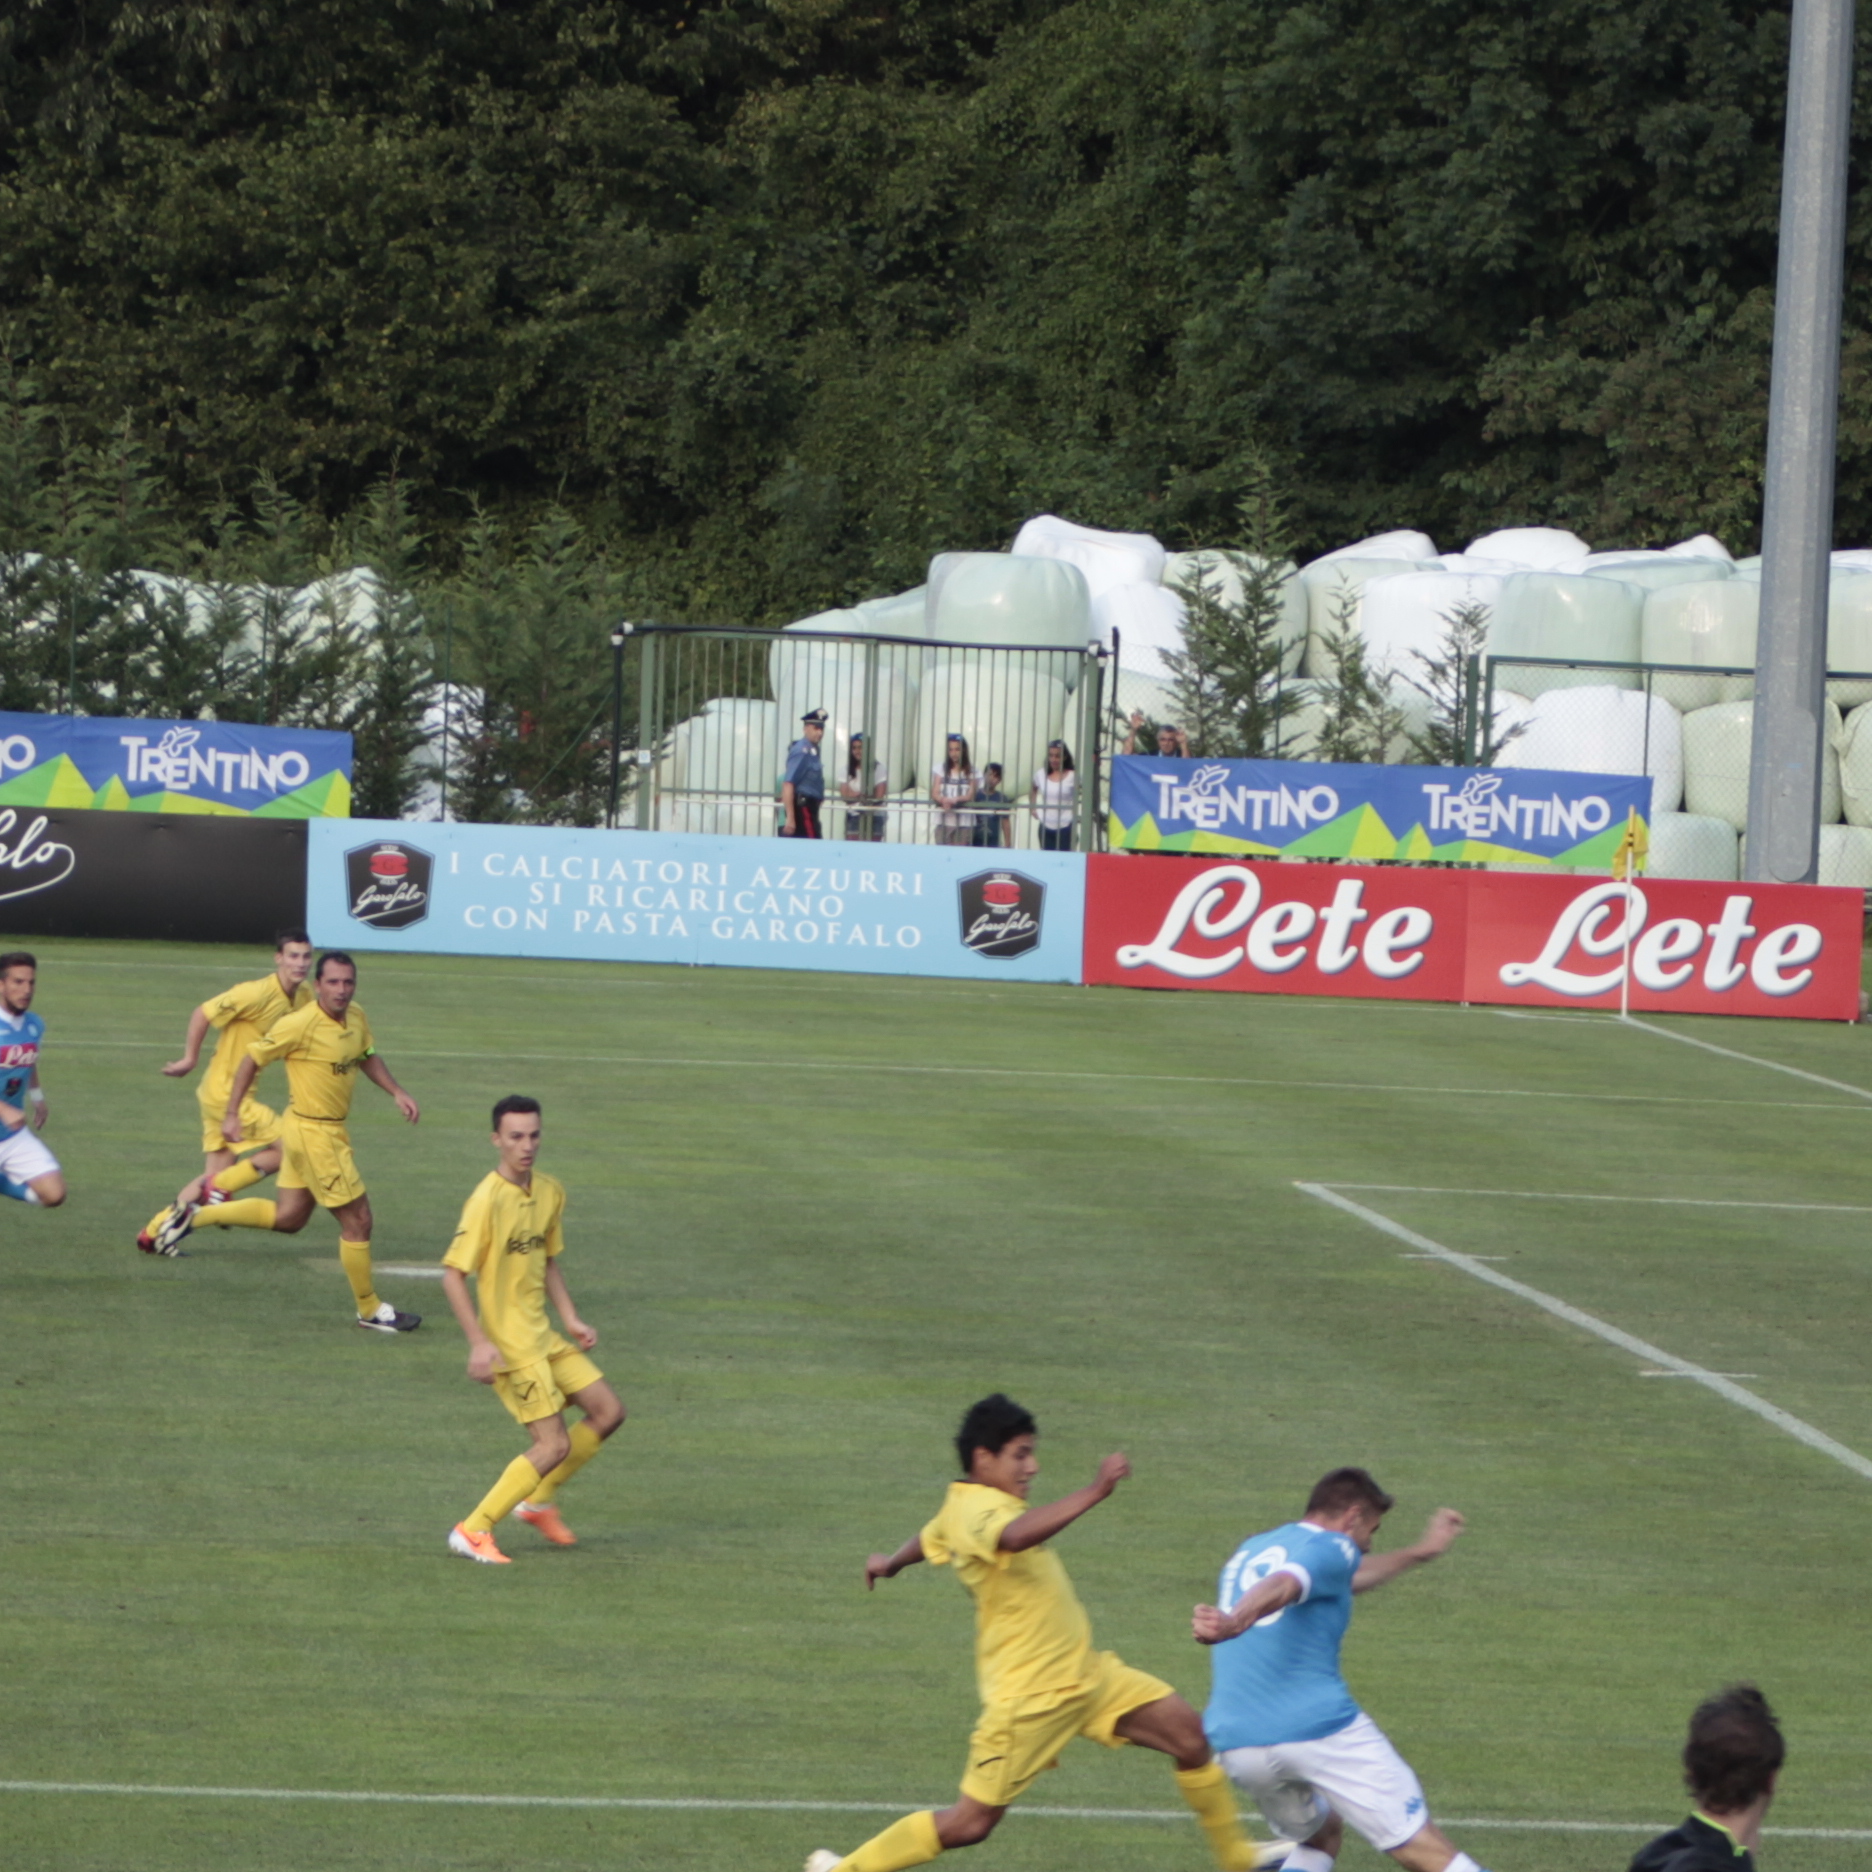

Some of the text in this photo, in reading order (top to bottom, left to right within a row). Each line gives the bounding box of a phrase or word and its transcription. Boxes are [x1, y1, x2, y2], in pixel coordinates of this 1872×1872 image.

[120, 735, 310, 794] TRENTINO
[1150, 773, 1340, 831] TRENTINO
[1421, 783, 1612, 842] TRENTINO
[449, 851, 924, 897] I CALCIATORI AZZURRI
[529, 881, 845, 919] SI RICARICANO
[351, 881, 427, 922] Garofalo
[463, 905, 923, 949] CON PASTA GAROFALO
[1115, 864, 1436, 980] Lete
[964, 911, 1039, 950] Garofalo
[1498, 880, 1826, 997] Lete
